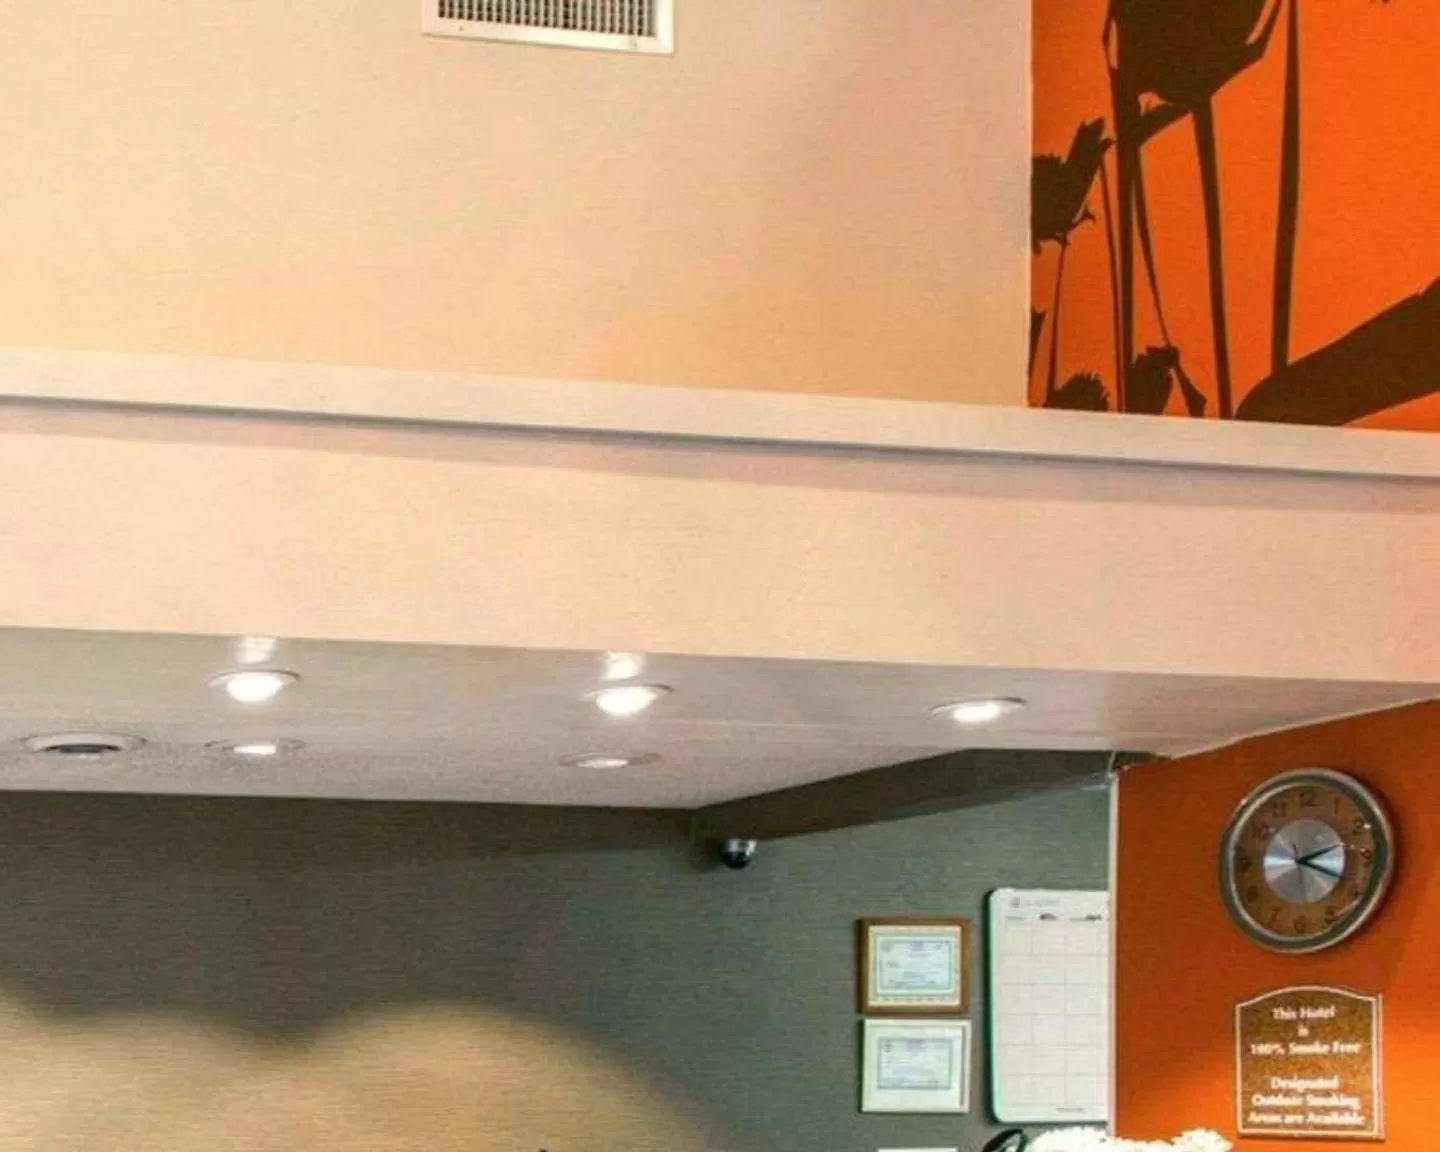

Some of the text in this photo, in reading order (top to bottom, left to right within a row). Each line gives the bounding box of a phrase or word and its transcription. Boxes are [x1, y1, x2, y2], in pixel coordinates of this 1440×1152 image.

[1300, 791, 1318, 807] 12
[1272, 1005, 1335, 1019] This Hotel
[1297, 1025, 1309, 1036] is
[1289, 1043, 1329, 1055] Smoke
[1332, 1040, 1361, 1054] Free
[1270, 1075, 1339, 1093] Designated
[1252, 1094, 1360, 1109] Outdoor Smoking
[1248, 1111, 1365, 1124] Areas are Available
